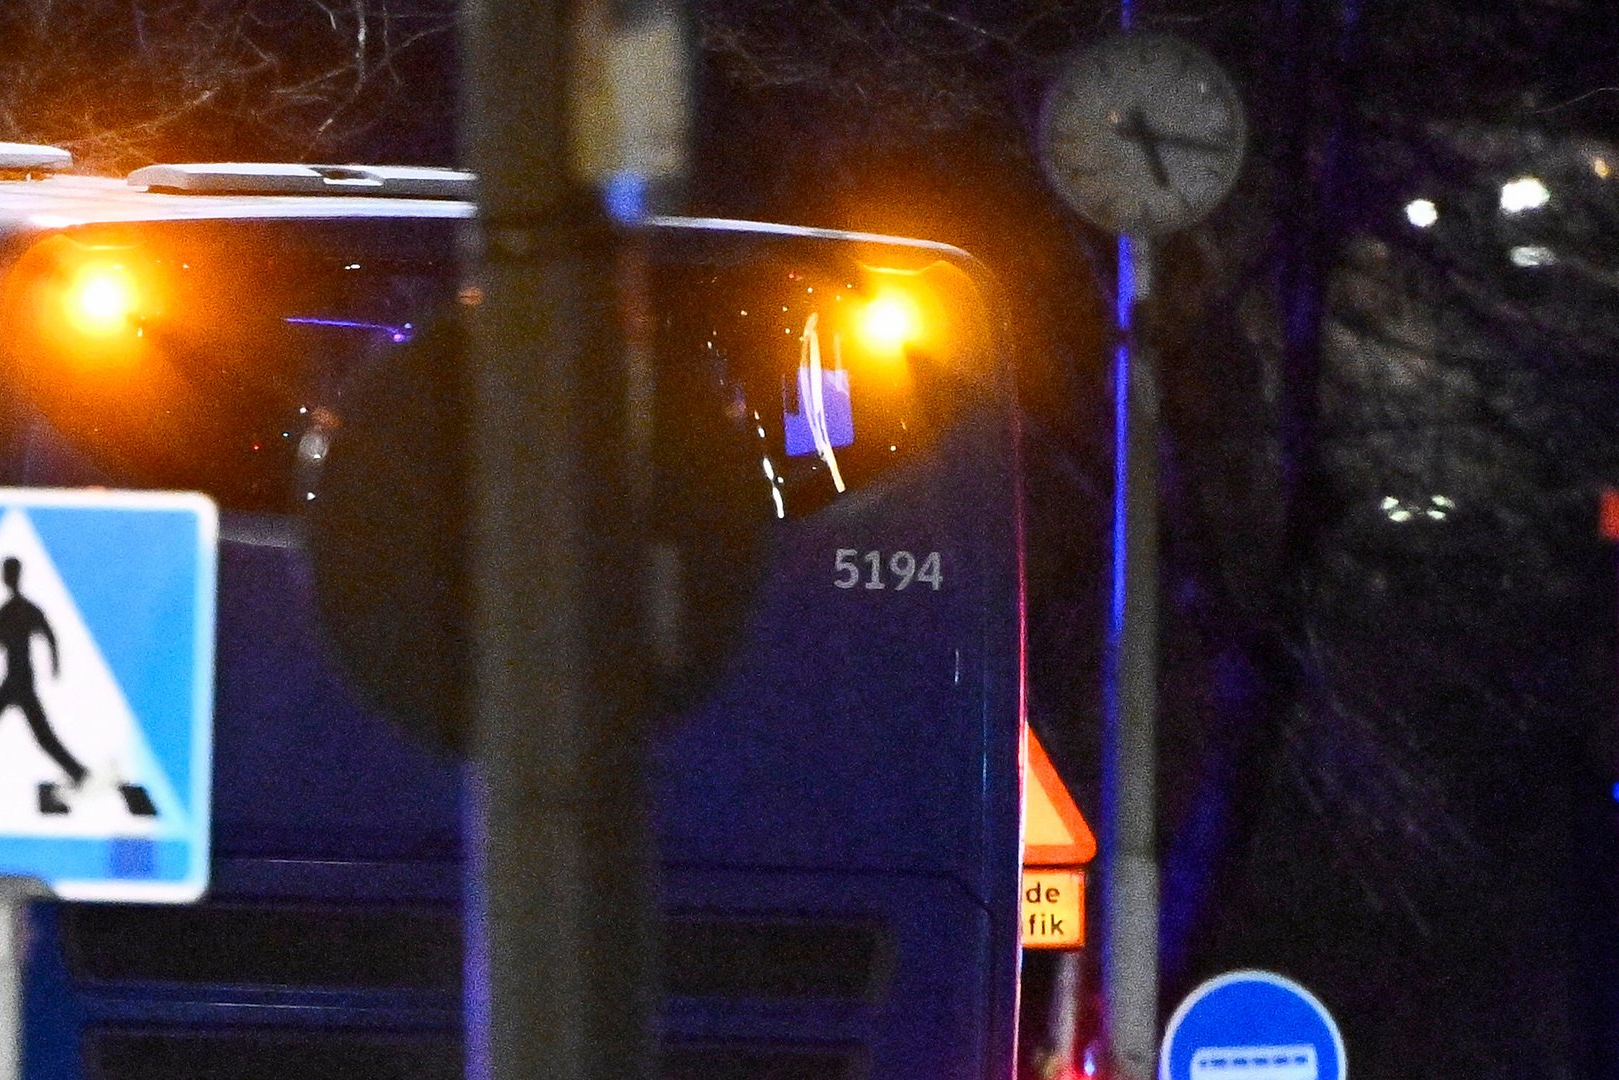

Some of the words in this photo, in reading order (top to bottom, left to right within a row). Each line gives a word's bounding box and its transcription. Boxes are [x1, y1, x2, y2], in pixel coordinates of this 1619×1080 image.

[833, 549, 943, 592] 5194
[1025, 882, 1061, 905] de
[1027, 913, 1065, 936] fik
